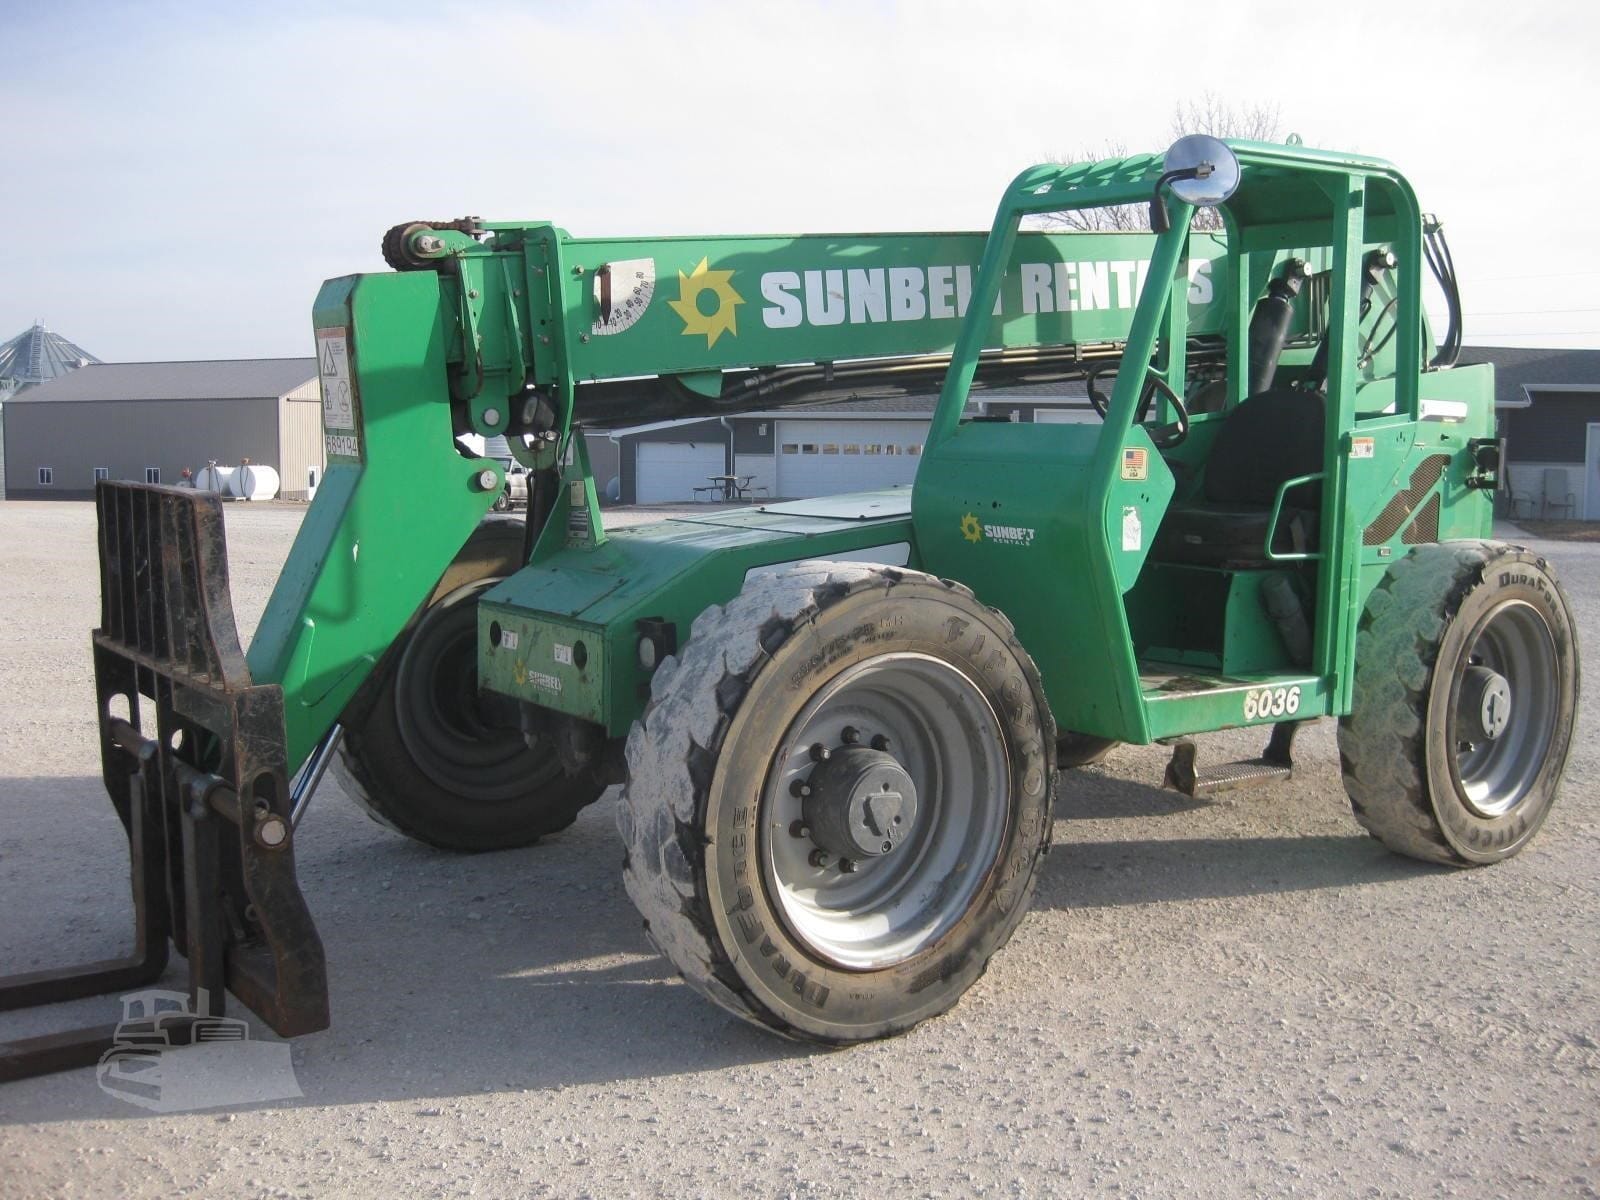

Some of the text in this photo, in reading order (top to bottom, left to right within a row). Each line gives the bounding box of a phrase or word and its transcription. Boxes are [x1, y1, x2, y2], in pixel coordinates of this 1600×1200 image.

[761, 259, 1213, 328] SUNBEL RENTS
[529, 670, 561, 690] SUNBEL
[1244, 686, 1301, 720] 6036
